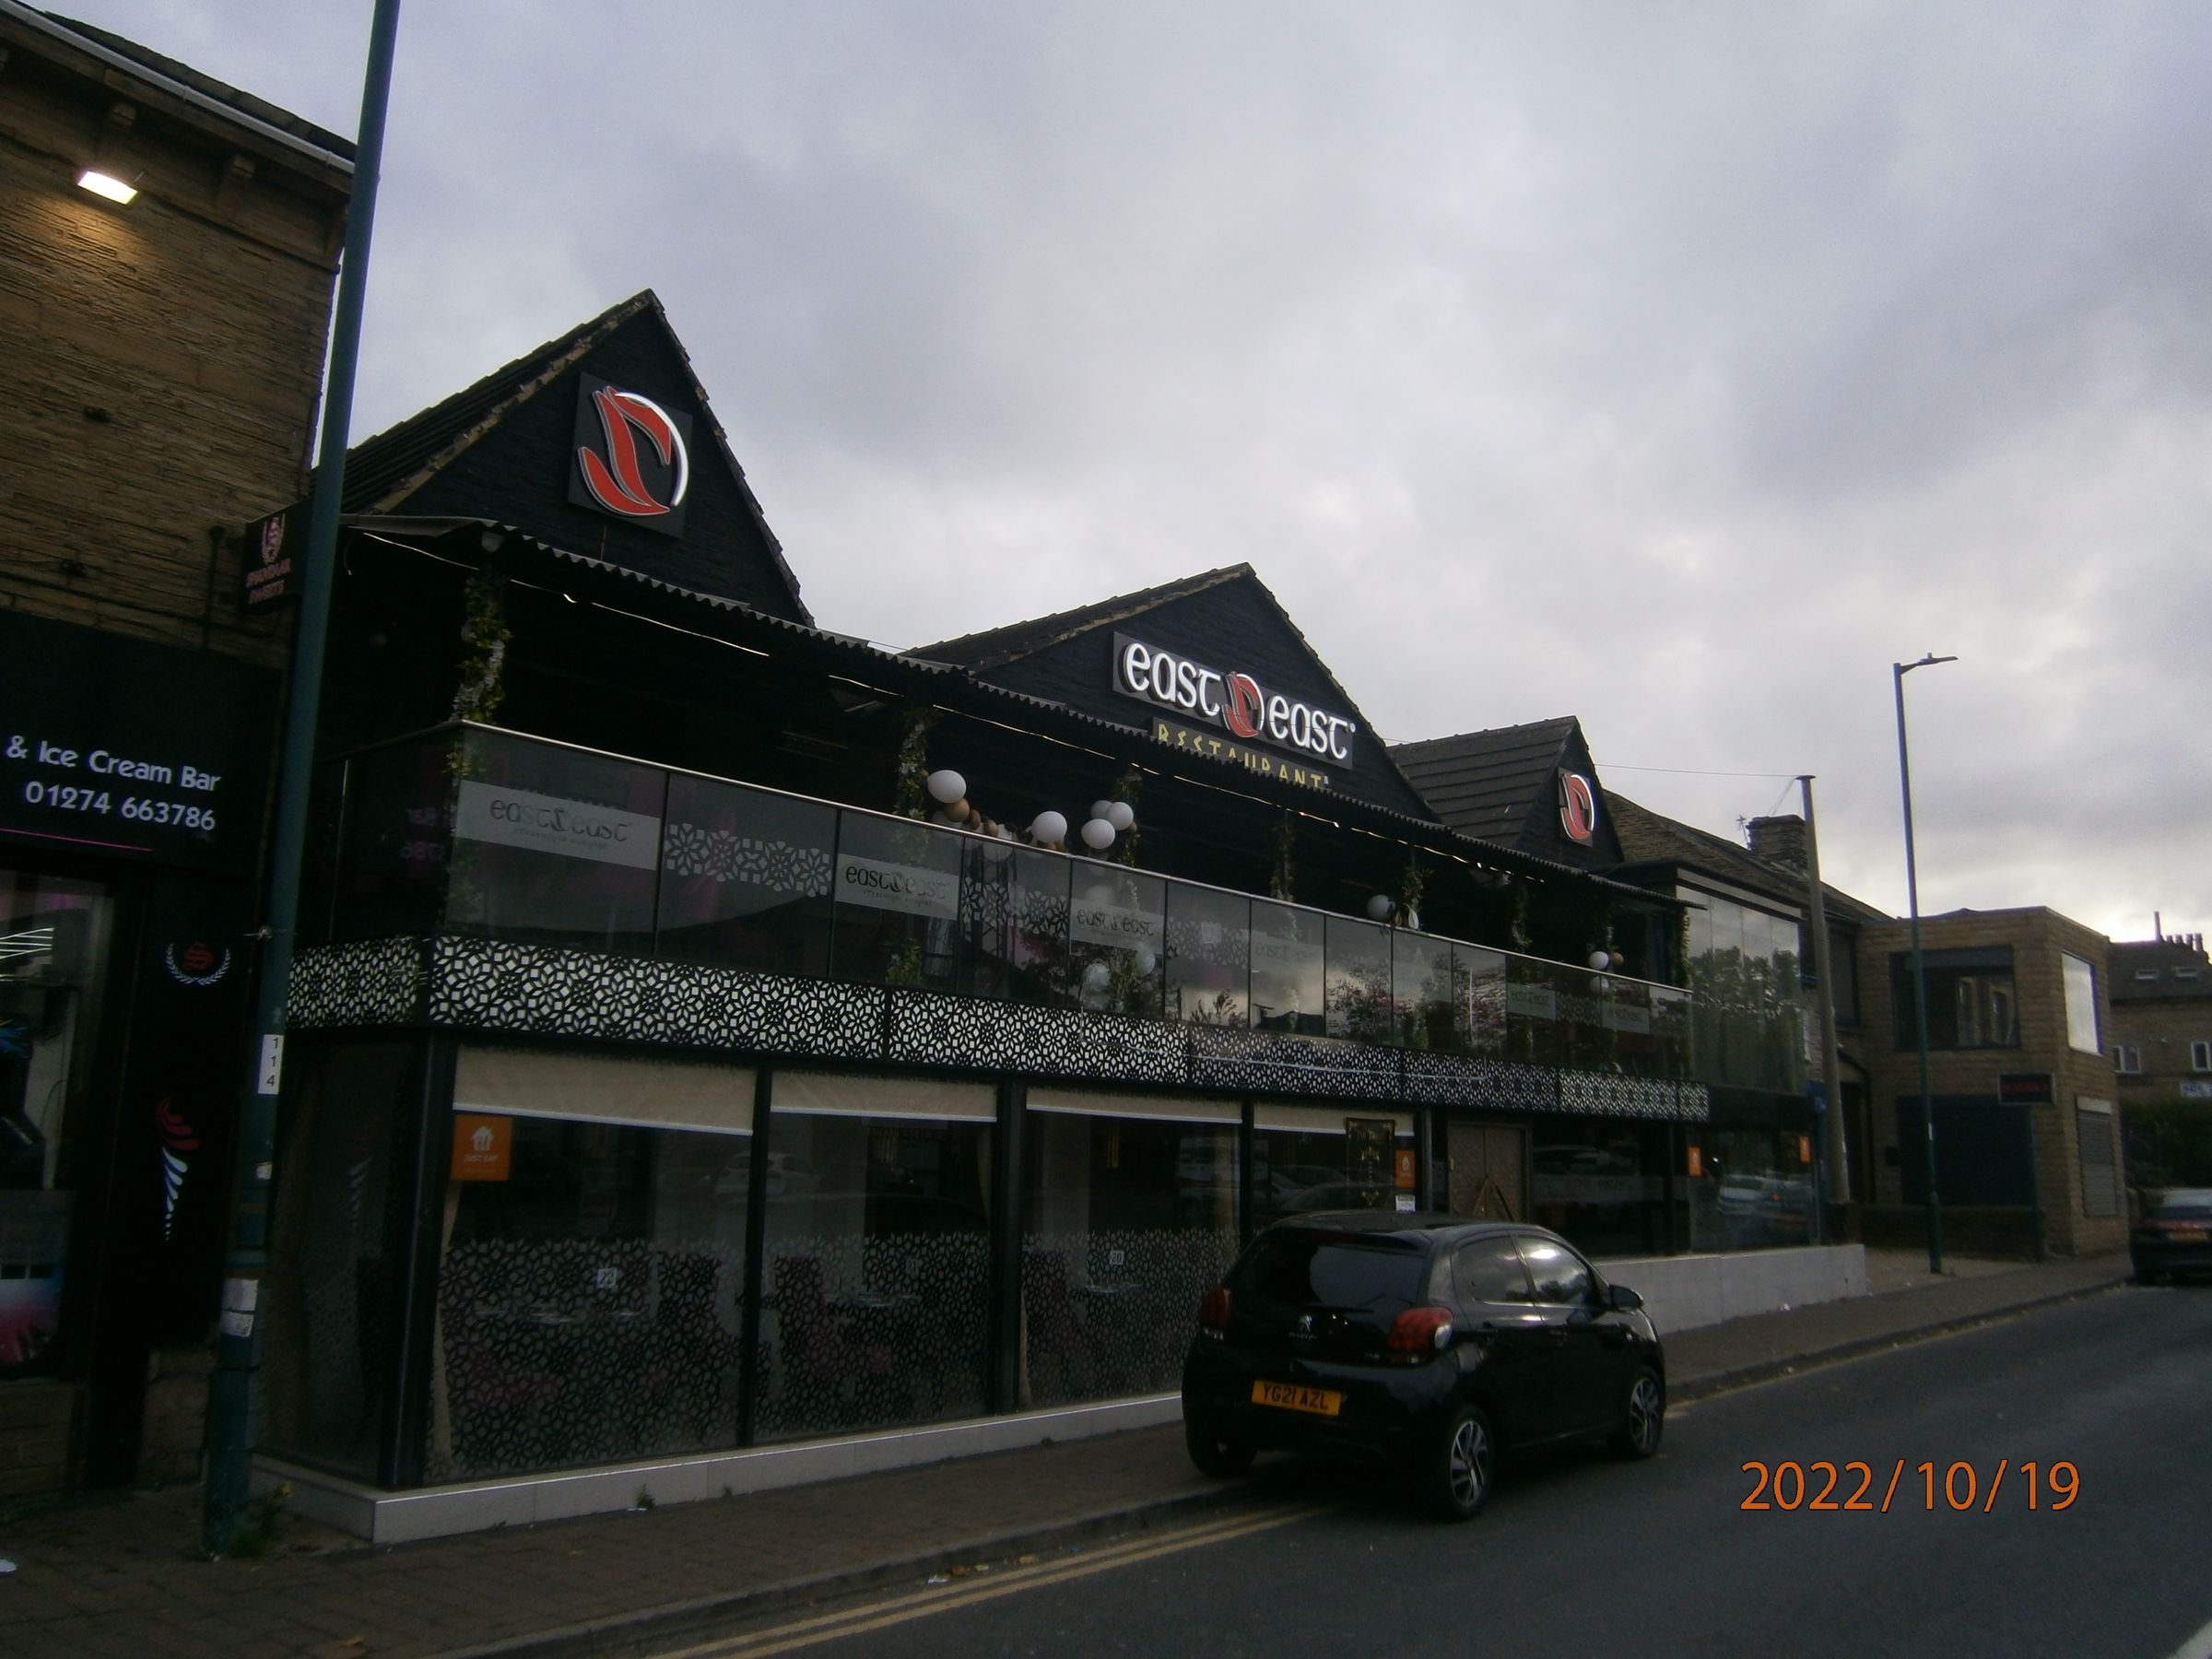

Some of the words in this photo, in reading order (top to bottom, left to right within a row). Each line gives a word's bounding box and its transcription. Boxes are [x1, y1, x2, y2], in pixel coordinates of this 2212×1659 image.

[1124, 642, 1221, 717] east
[1267, 694, 1348, 760] east
[6, 735, 28, 759] &
[38, 739, 79, 768] Ice
[88, 749, 172, 784] Cream
[181, 765, 222, 792] Bar
[25, 781, 112, 815] 01274
[121, 796, 216, 831] 663786
[845, 865, 890, 890] east
[1262, 1384, 1296, 1405] YG21
[1299, 1389, 1329, 1410] AZL
